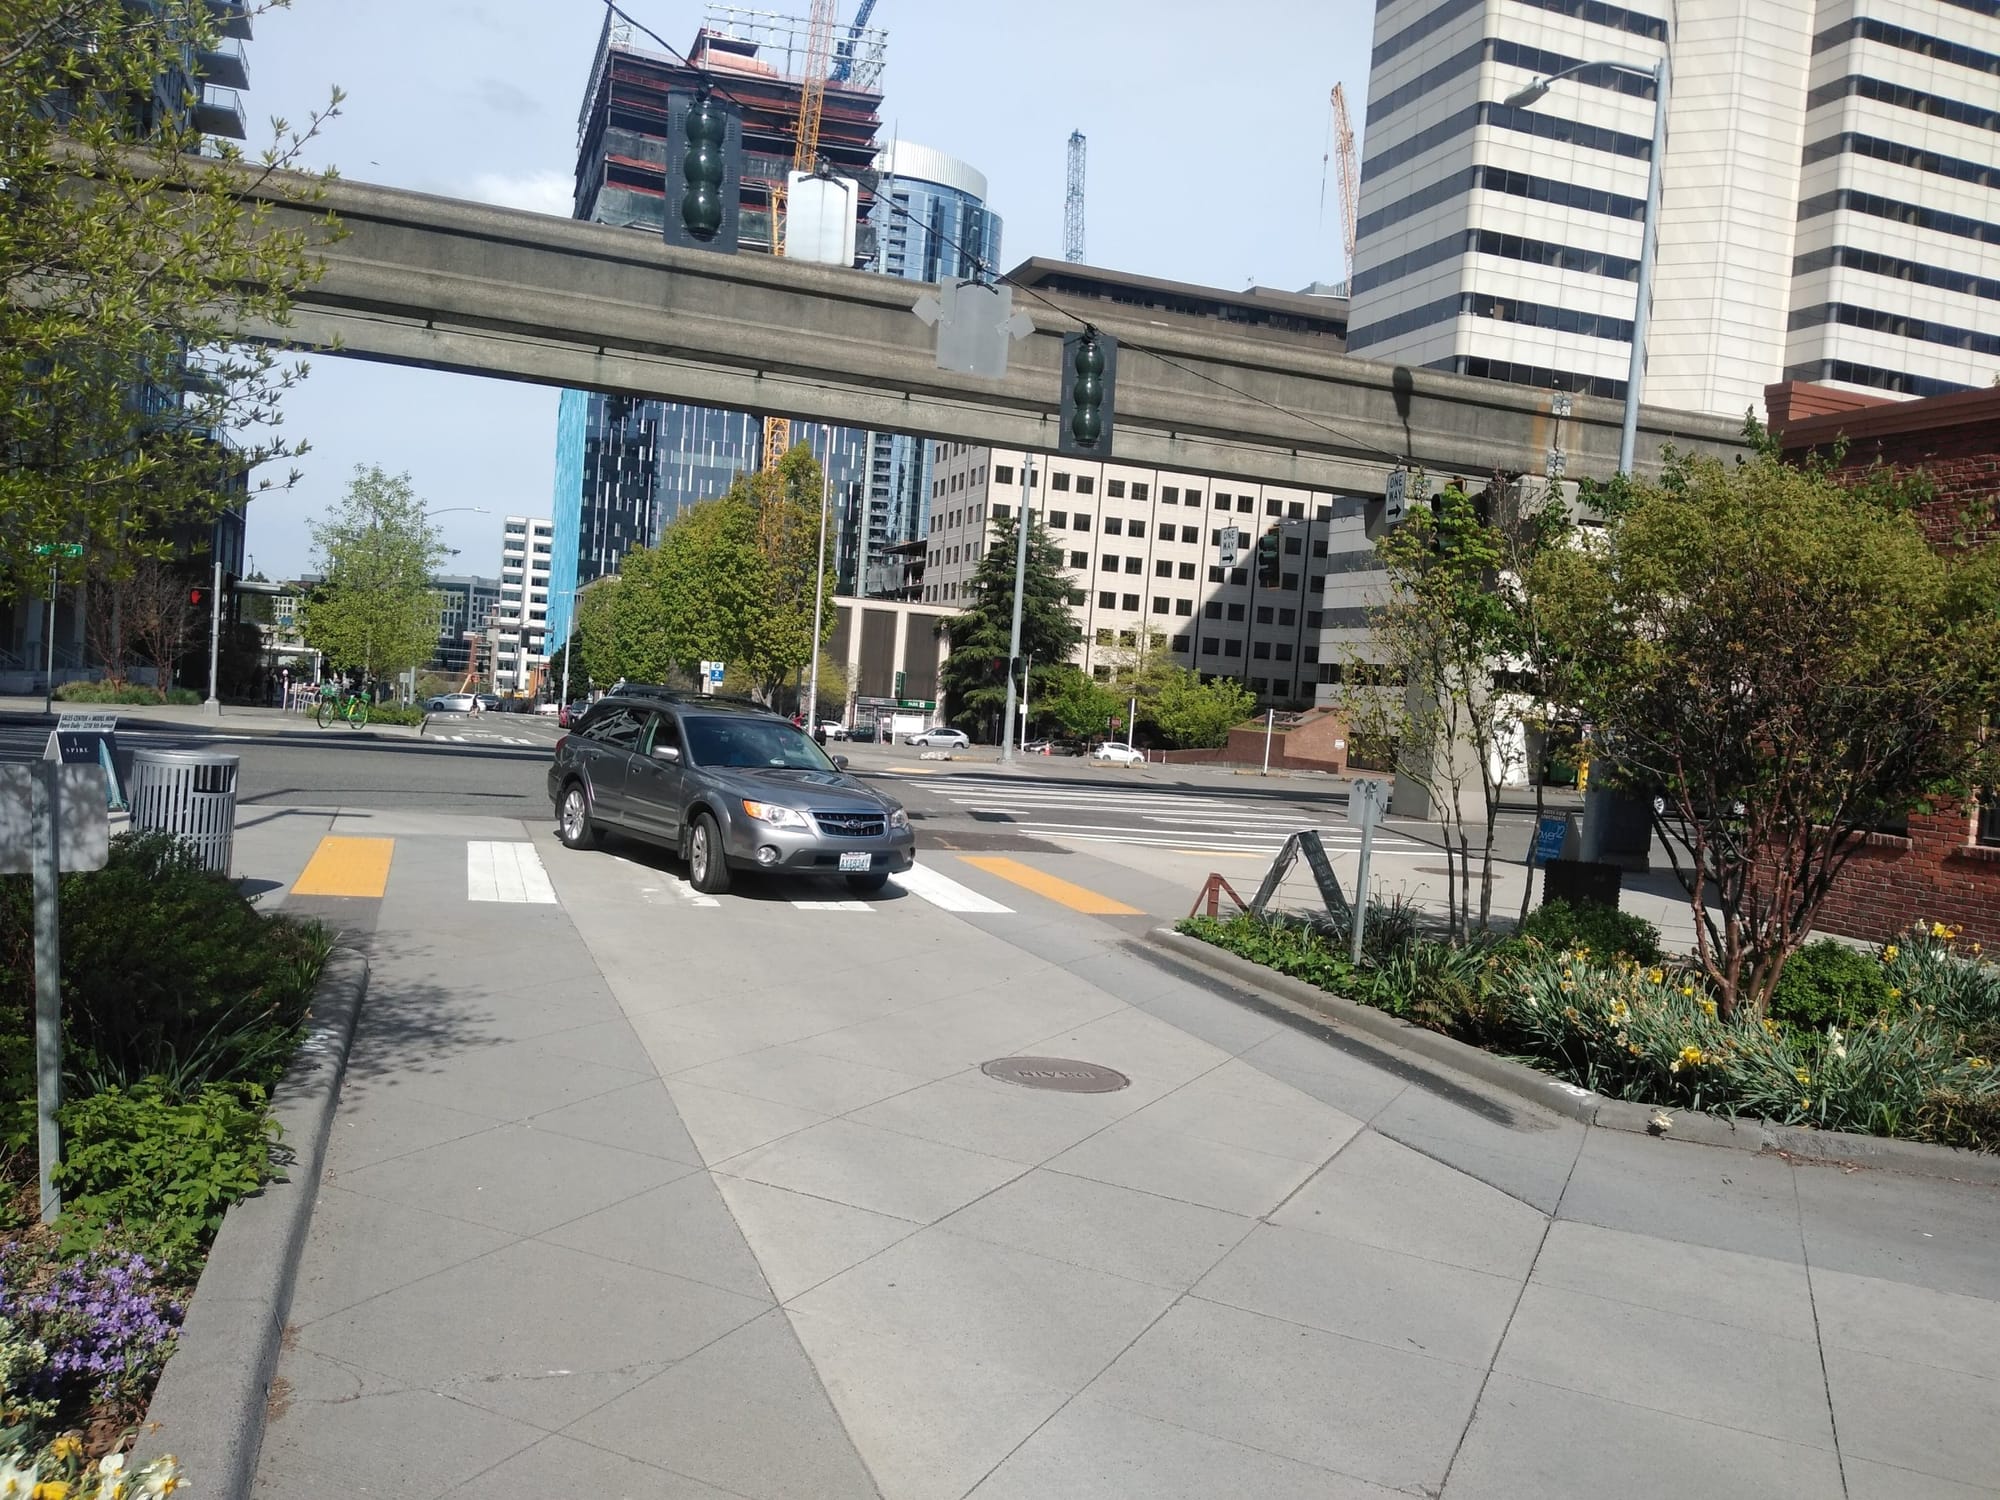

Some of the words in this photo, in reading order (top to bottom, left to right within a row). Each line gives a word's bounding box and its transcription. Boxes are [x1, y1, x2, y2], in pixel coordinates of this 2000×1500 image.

[1389, 475, 1403, 488] ONE
[1389, 488, 1403, 501] WAY
[1223, 530, 1235, 540] ONE
[1223, 541, 1235, 550] WAY
[1017, 1071, 1095, 1079] DRAIN
